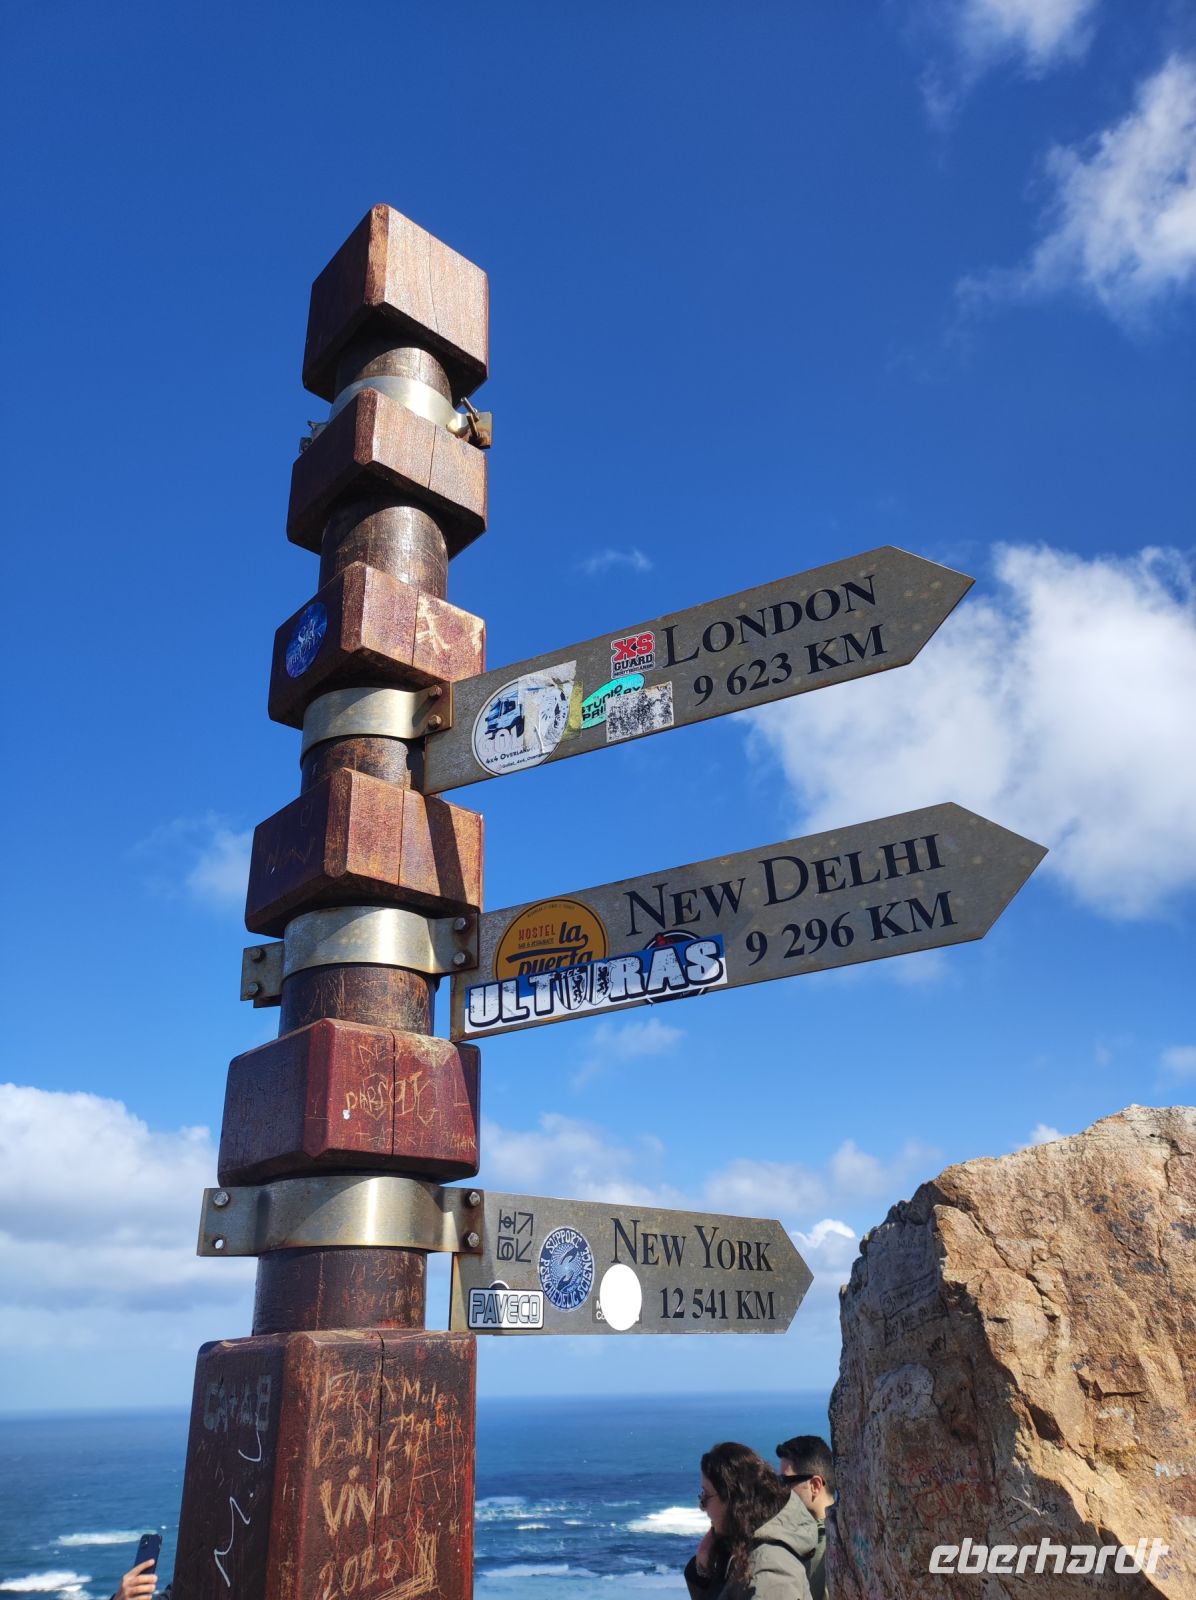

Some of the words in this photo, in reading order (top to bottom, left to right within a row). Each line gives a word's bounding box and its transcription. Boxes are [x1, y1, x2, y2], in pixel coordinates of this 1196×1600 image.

[662, 575, 878, 668] LONDON
[613, 632, 655, 661] XS
[614, 653, 654, 672] GUARD
[693, 674, 715, 707] 9
[726, 652, 793, 696] 623
[805, 623, 888, 675] KM
[624, 877, 746, 937] NEW
[759, 834, 946, 907] DELHI
[518, 923, 556, 941] HOSTEL
[558, 921, 590, 945] la
[746, 931, 768, 967] 9
[783, 911, 855, 959] 296
[866, 890, 958, 942] KM
[545, 1229, 584, 1254] SUPPORT
[611, 1217, 687, 1266] NEW
[695, 1224, 774, 1272] YORK
[540, 1257, 580, 1308] PSYCHEDELIC
[579, 1246, 594, 1300] SCIENCE
[660, 1287, 686, 1319] 12
[692, 1288, 727, 1319] 541
[735, 1289, 777, 1320] KM
